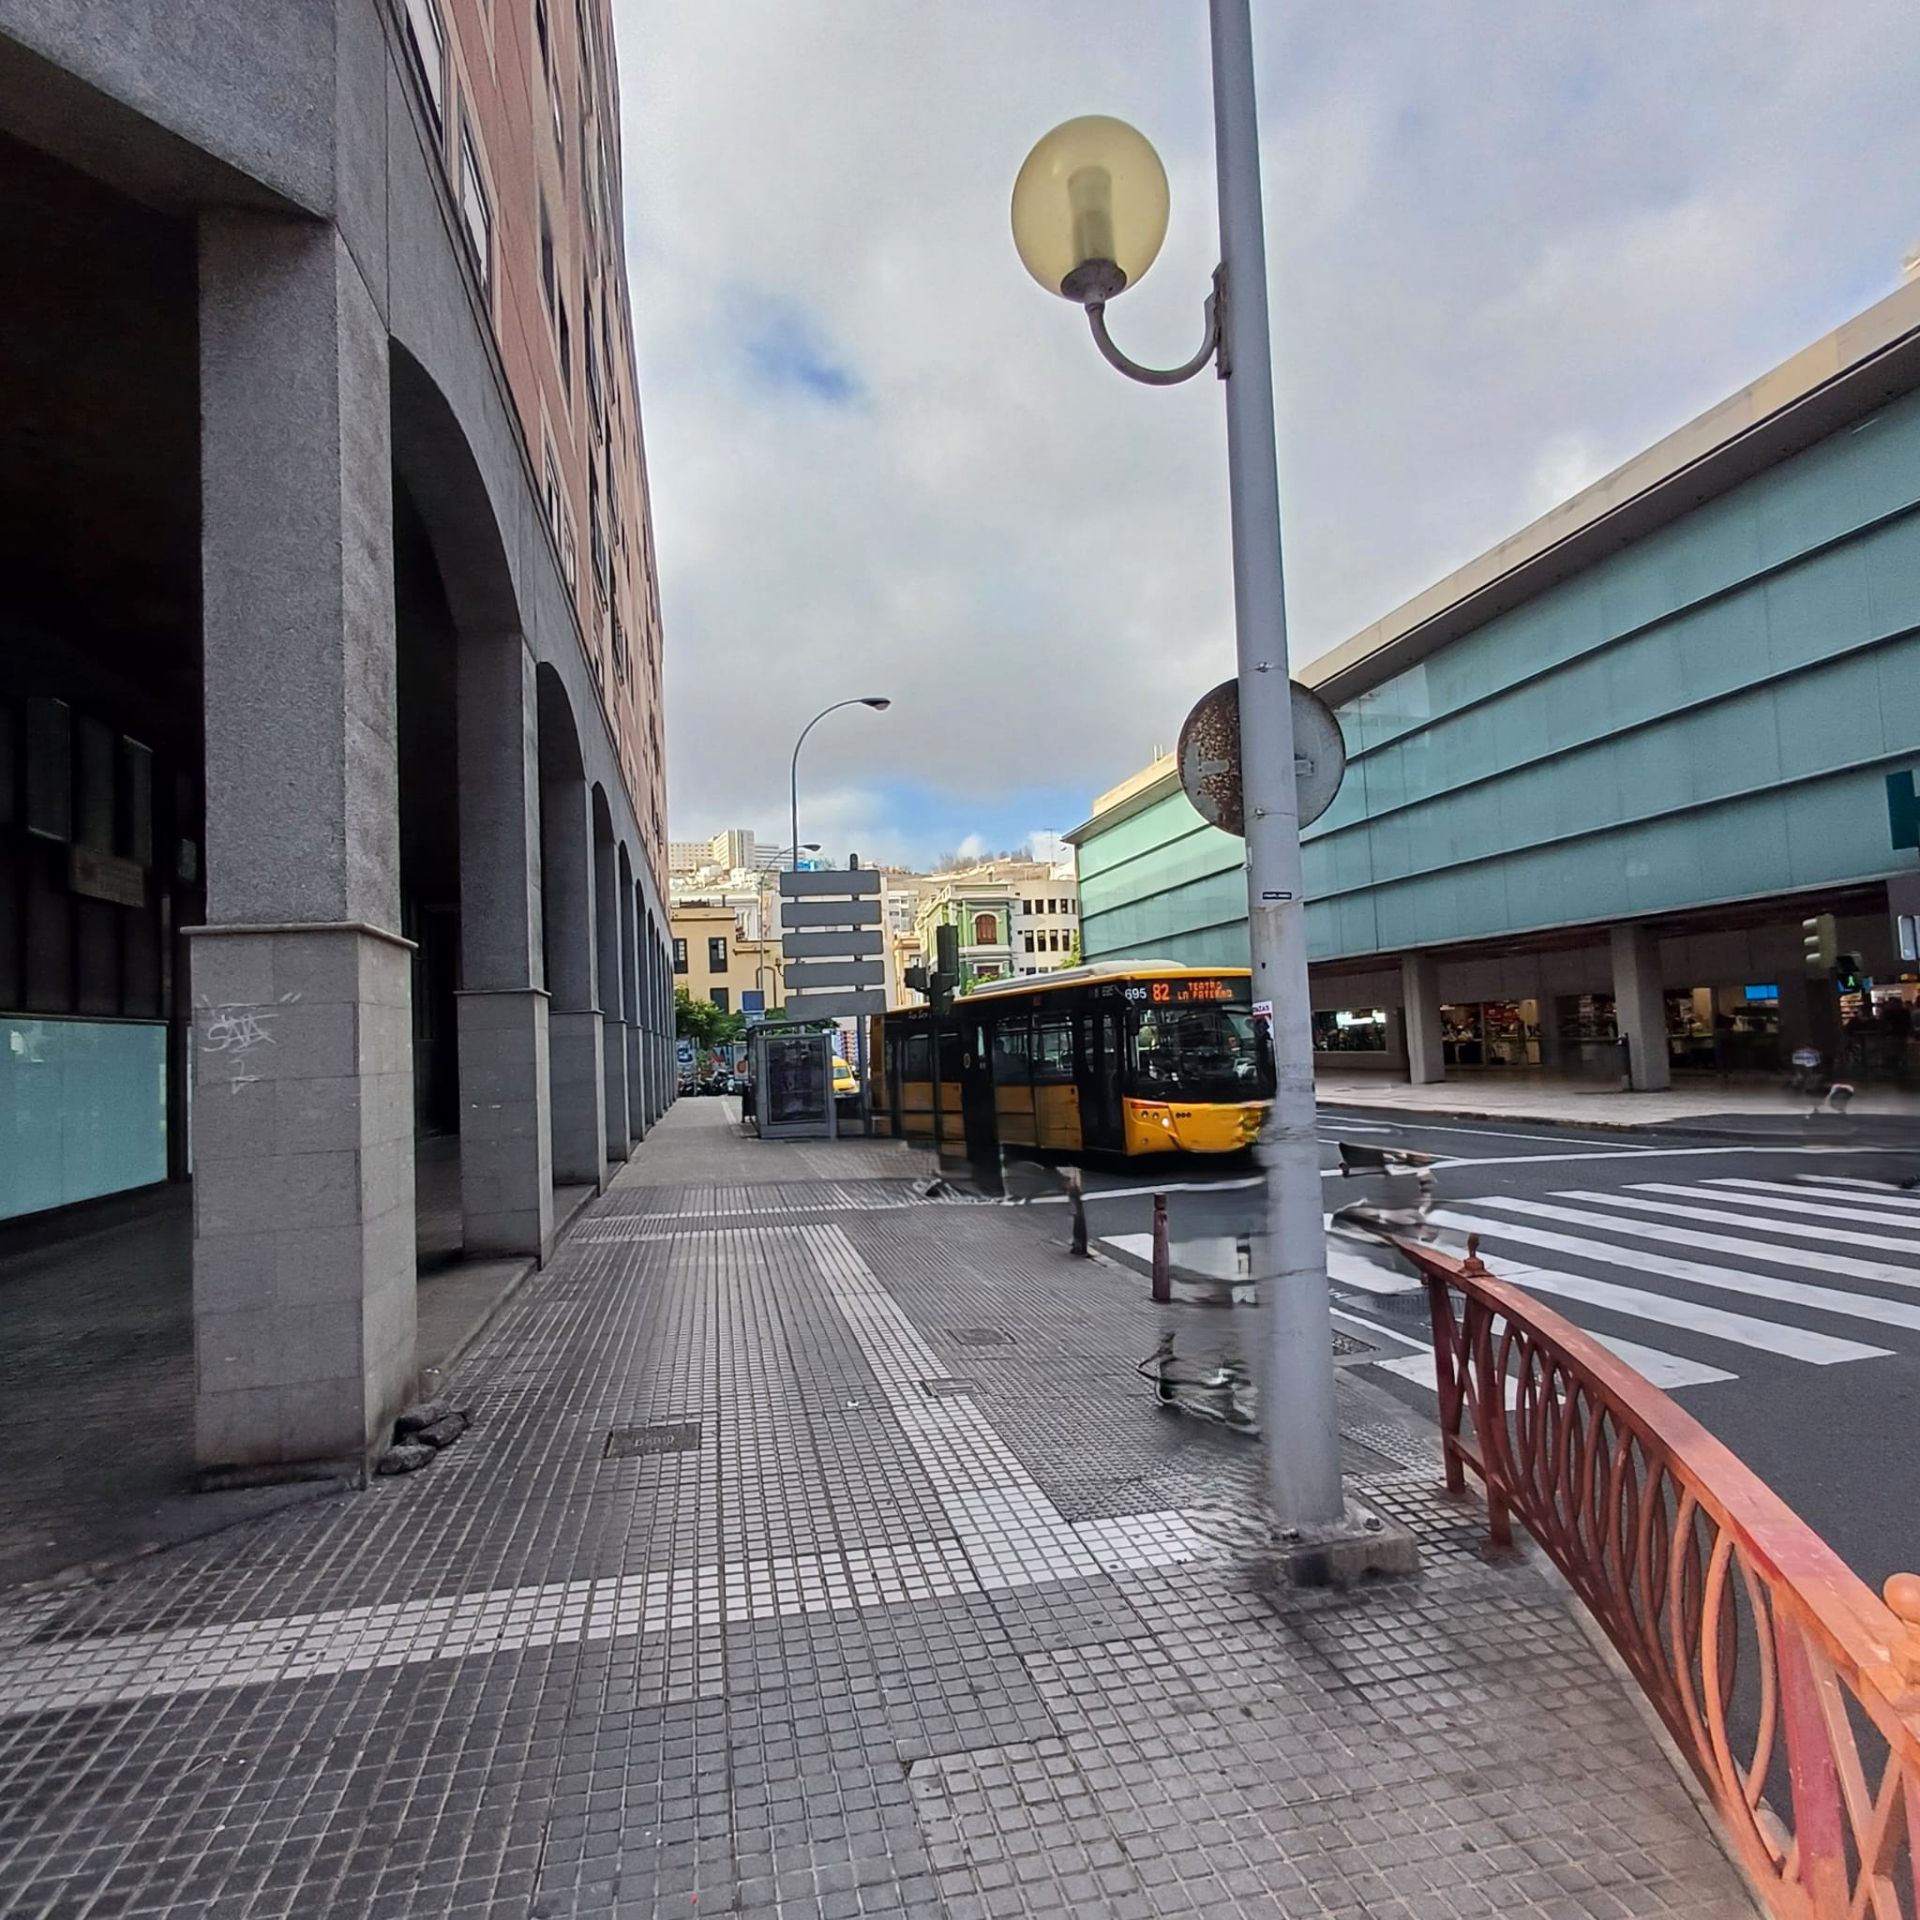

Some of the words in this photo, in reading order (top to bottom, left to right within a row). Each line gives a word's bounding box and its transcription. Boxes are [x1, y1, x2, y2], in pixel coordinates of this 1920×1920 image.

[1152, 983, 1170, 1001] 82
[1188, 981, 1222, 991] TEATRO
[1124, 988, 1147, 1000] 695
